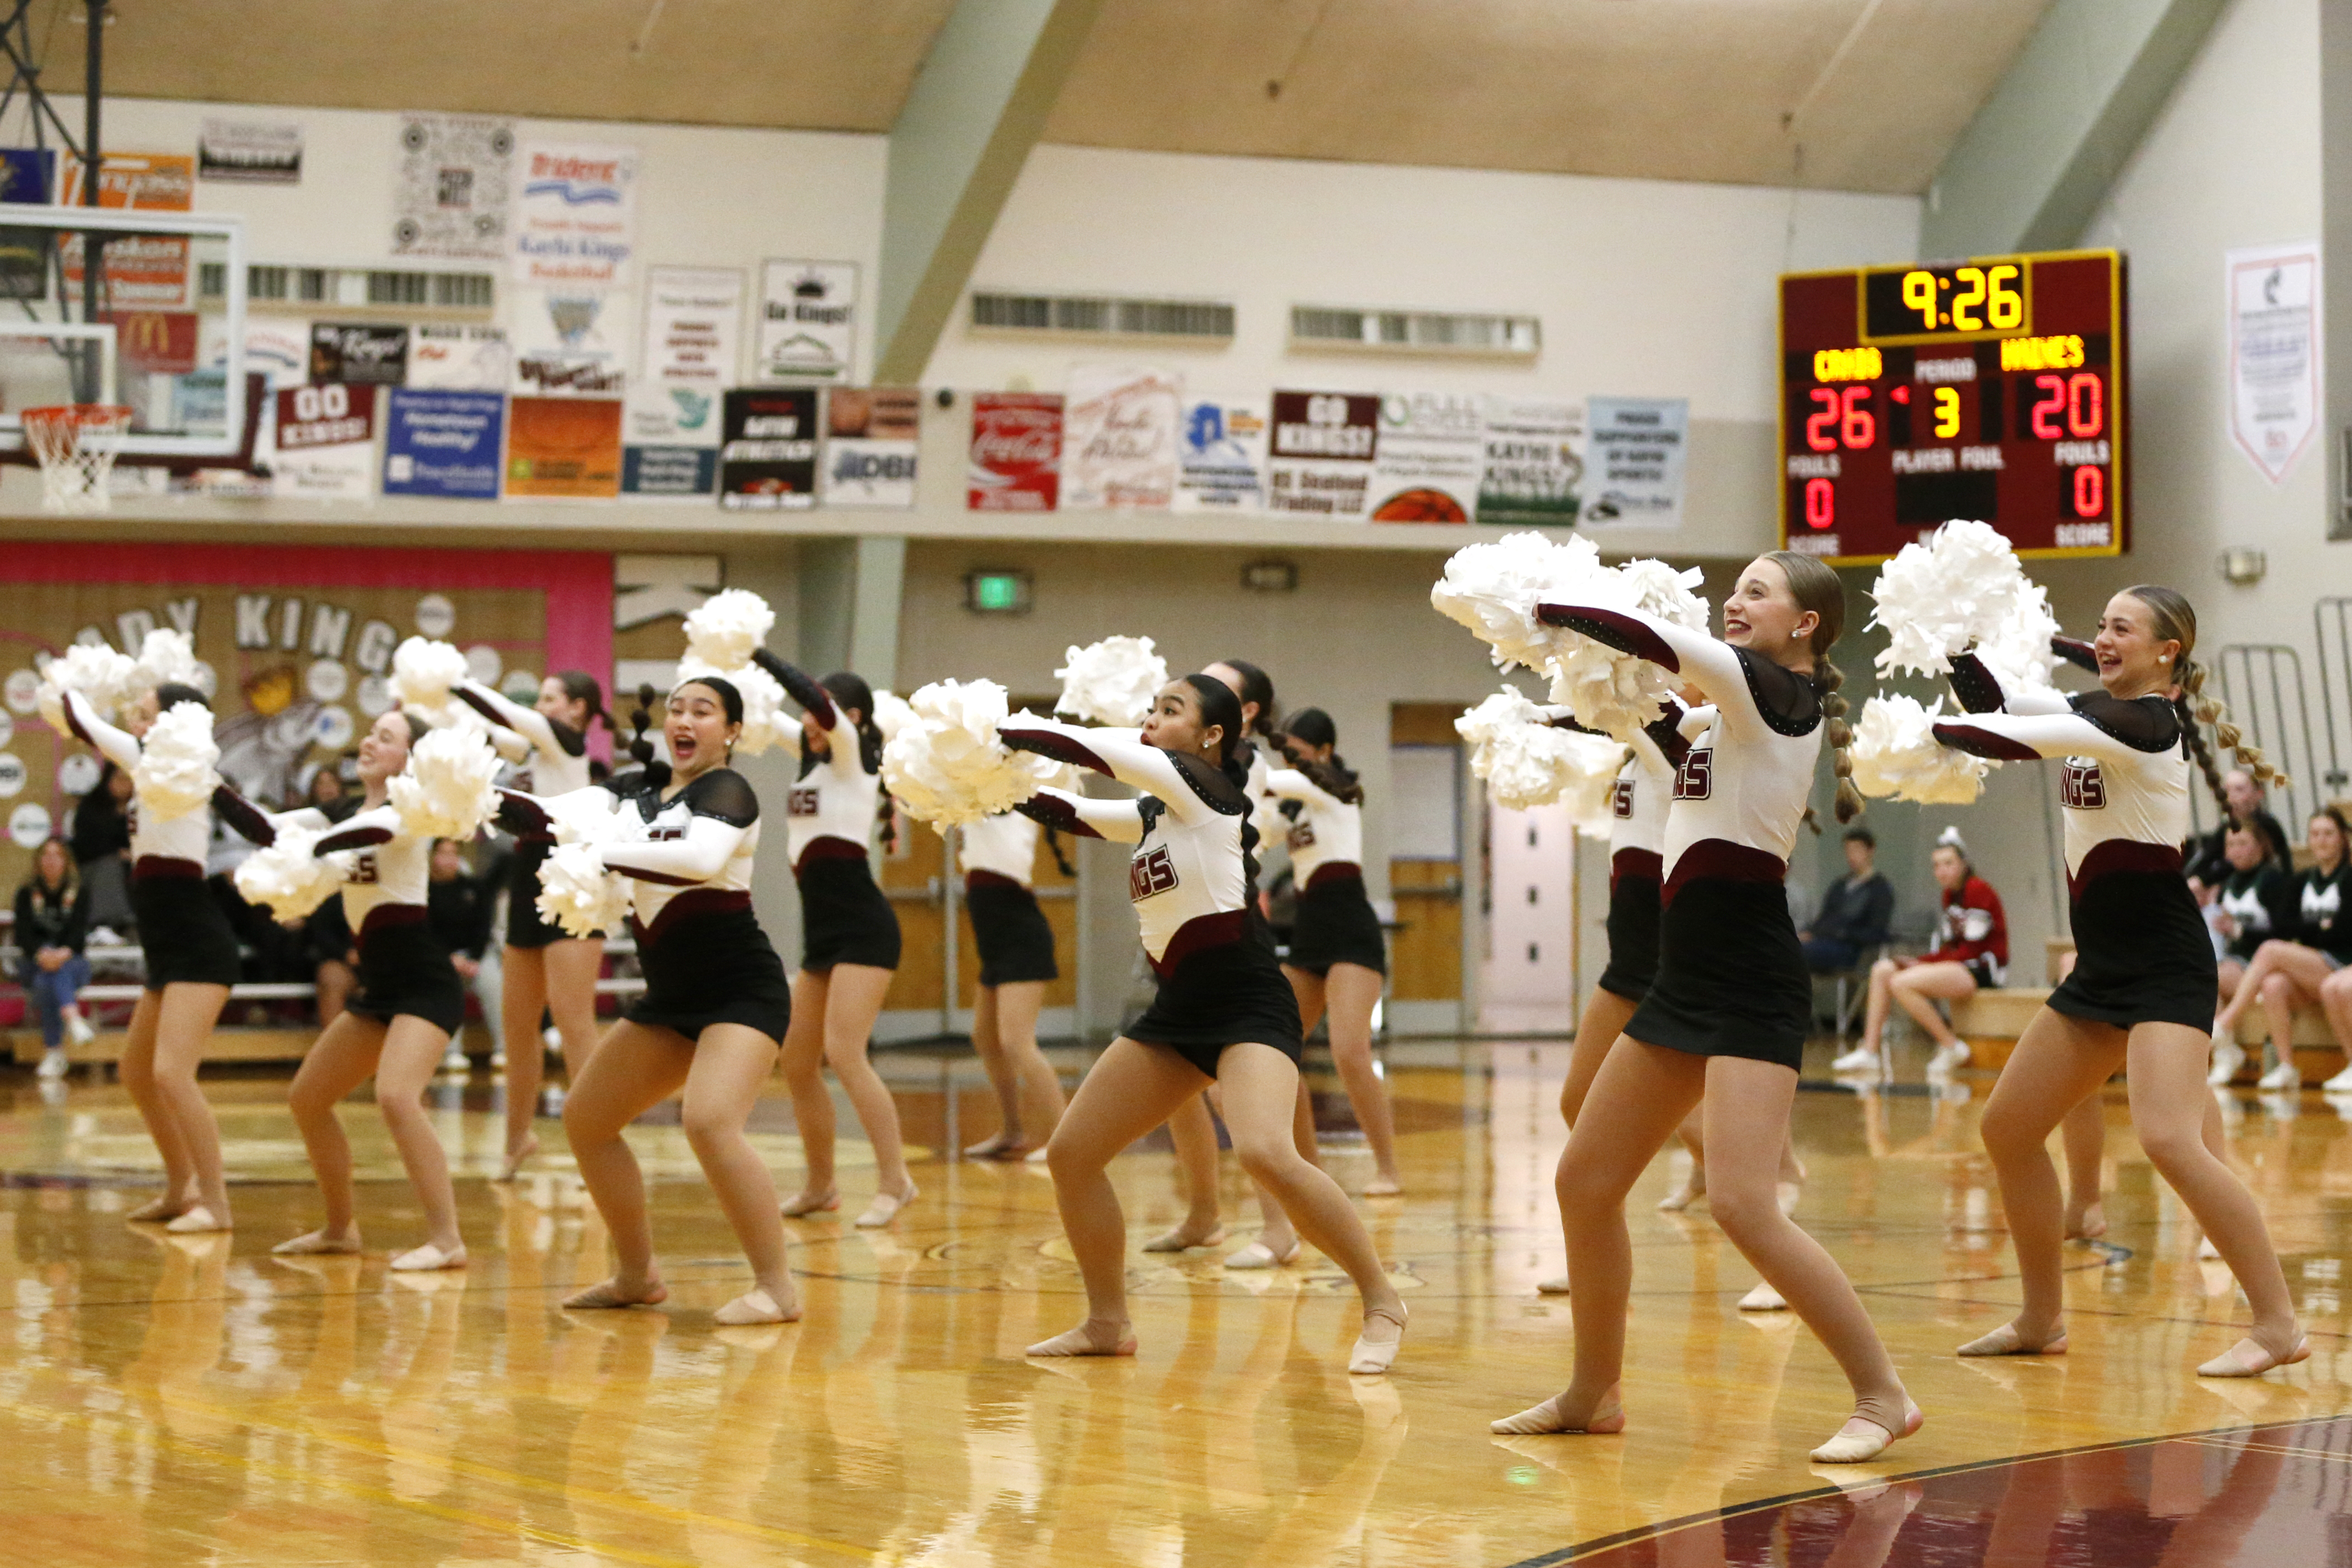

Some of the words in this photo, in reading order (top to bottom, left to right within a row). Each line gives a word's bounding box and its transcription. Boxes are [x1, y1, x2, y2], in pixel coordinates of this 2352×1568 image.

[1903, 265, 2022, 331] 9:26
[1915, 358, 1977, 382] PERIOD
[1306, 396, 1350, 425] GO
[1806, 386, 1876, 451] 26
[1934, 387, 1960, 438] 3
[2032, 373, 2103, 439] 20
[1788, 454, 1841, 477] FOULS
[1892, 448, 1955, 472] PLAYER
[1960, 446, 2004, 469] FOUL
[2054, 440, 2110, 464] FOULS
[1806, 478, 1834, 528] 0
[2073, 465, 2103, 517] 0
[2055, 523, 2110, 547] SCORE
